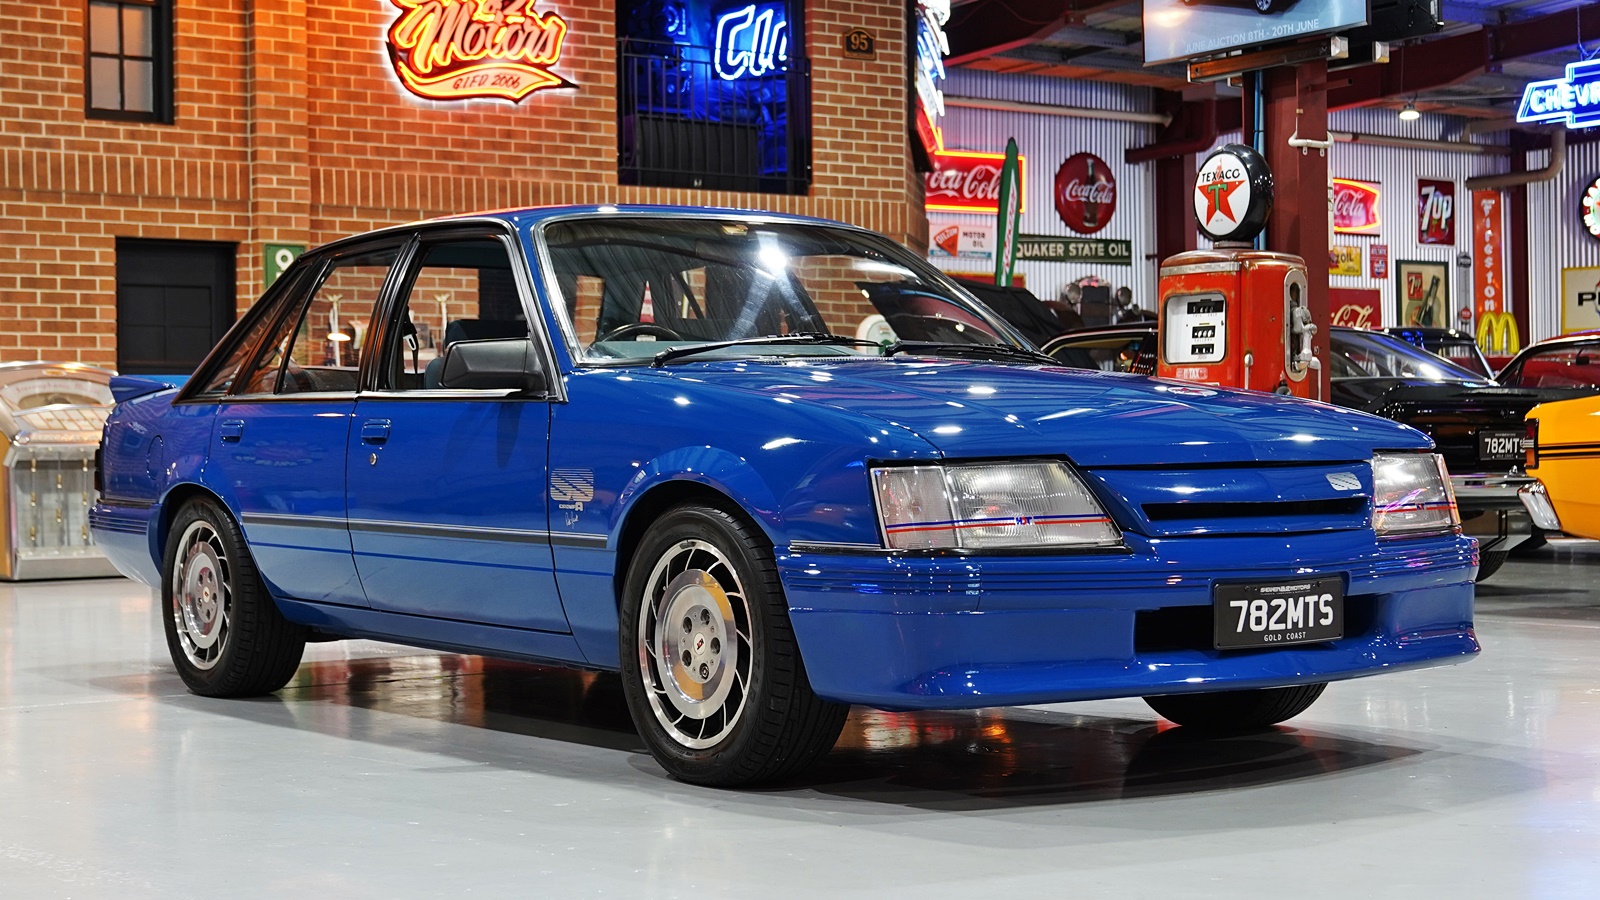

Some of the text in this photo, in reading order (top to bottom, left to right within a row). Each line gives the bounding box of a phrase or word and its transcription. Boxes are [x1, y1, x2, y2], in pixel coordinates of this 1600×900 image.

[399, 1, 561, 72] Motors
[851, 33, 869, 50] 95
[1185, 41, 1206, 53] JUNE
[1208, 33, 1246, 47] AUCTION
[1248, 29, 1265, 41] 8TH
[1272, 24, 1294, 37] 20TH
[1296, 19, 1320, 32] JUNE
[491, 75, 520, 89] 2006
[1202, 168, 1241, 183] TEXACO
[962, 231, 986, 239] MOTOR
[972, 240, 984, 248] OIL
[1068, 243, 1105, 256] STATE
[1108, 243, 1129, 256] OIL
[1229, 593, 1334, 633] 782MTS
[1263, 631, 1307, 642] GOLD COAST
